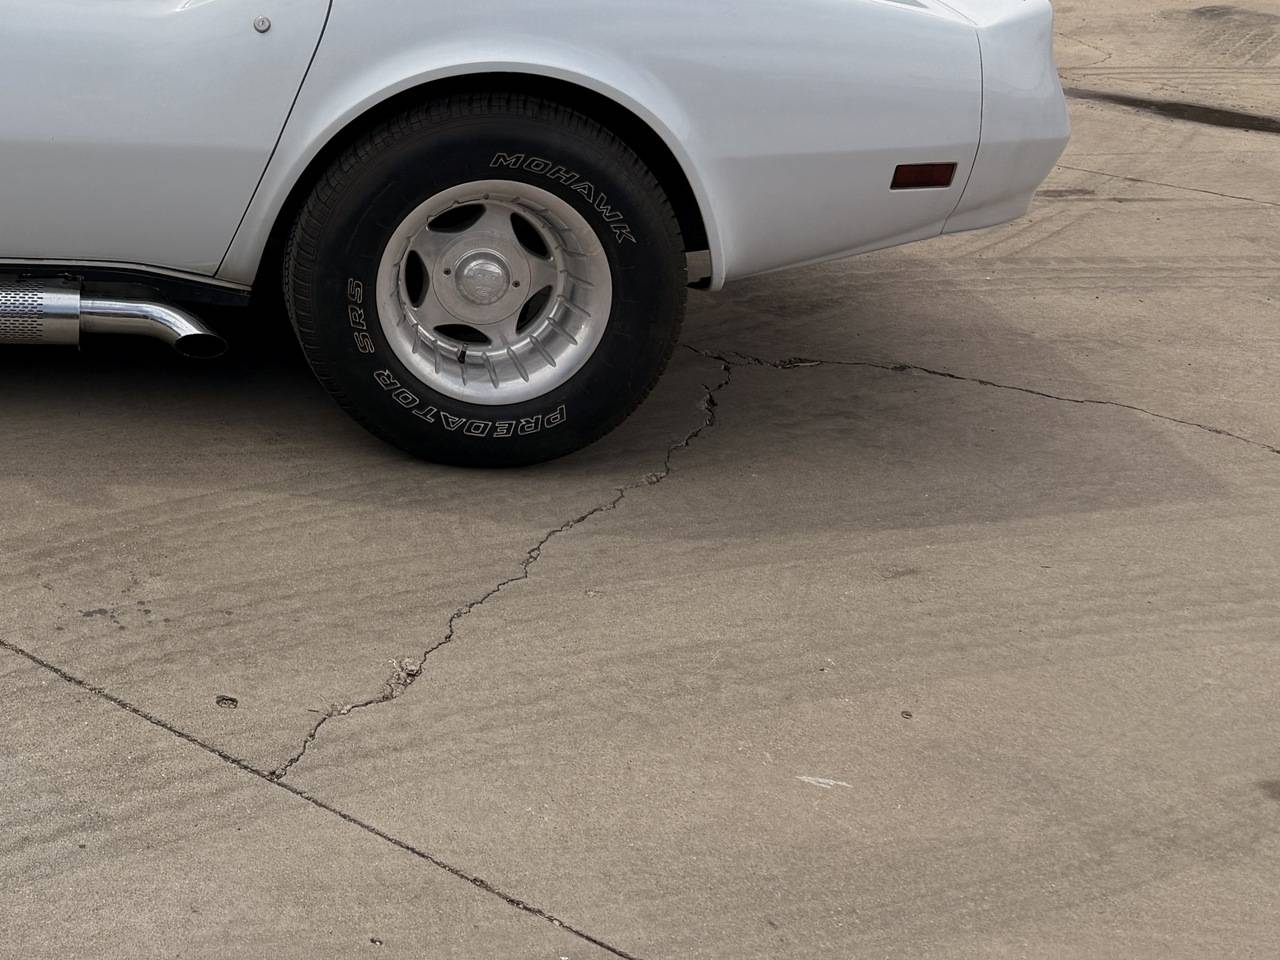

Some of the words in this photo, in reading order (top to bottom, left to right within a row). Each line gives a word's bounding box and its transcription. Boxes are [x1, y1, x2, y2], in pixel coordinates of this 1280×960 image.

[489, 151, 637, 245] MOHAWK
[347, 277, 376, 355] SRS
[373, 369, 569, 438] PREDATOR
